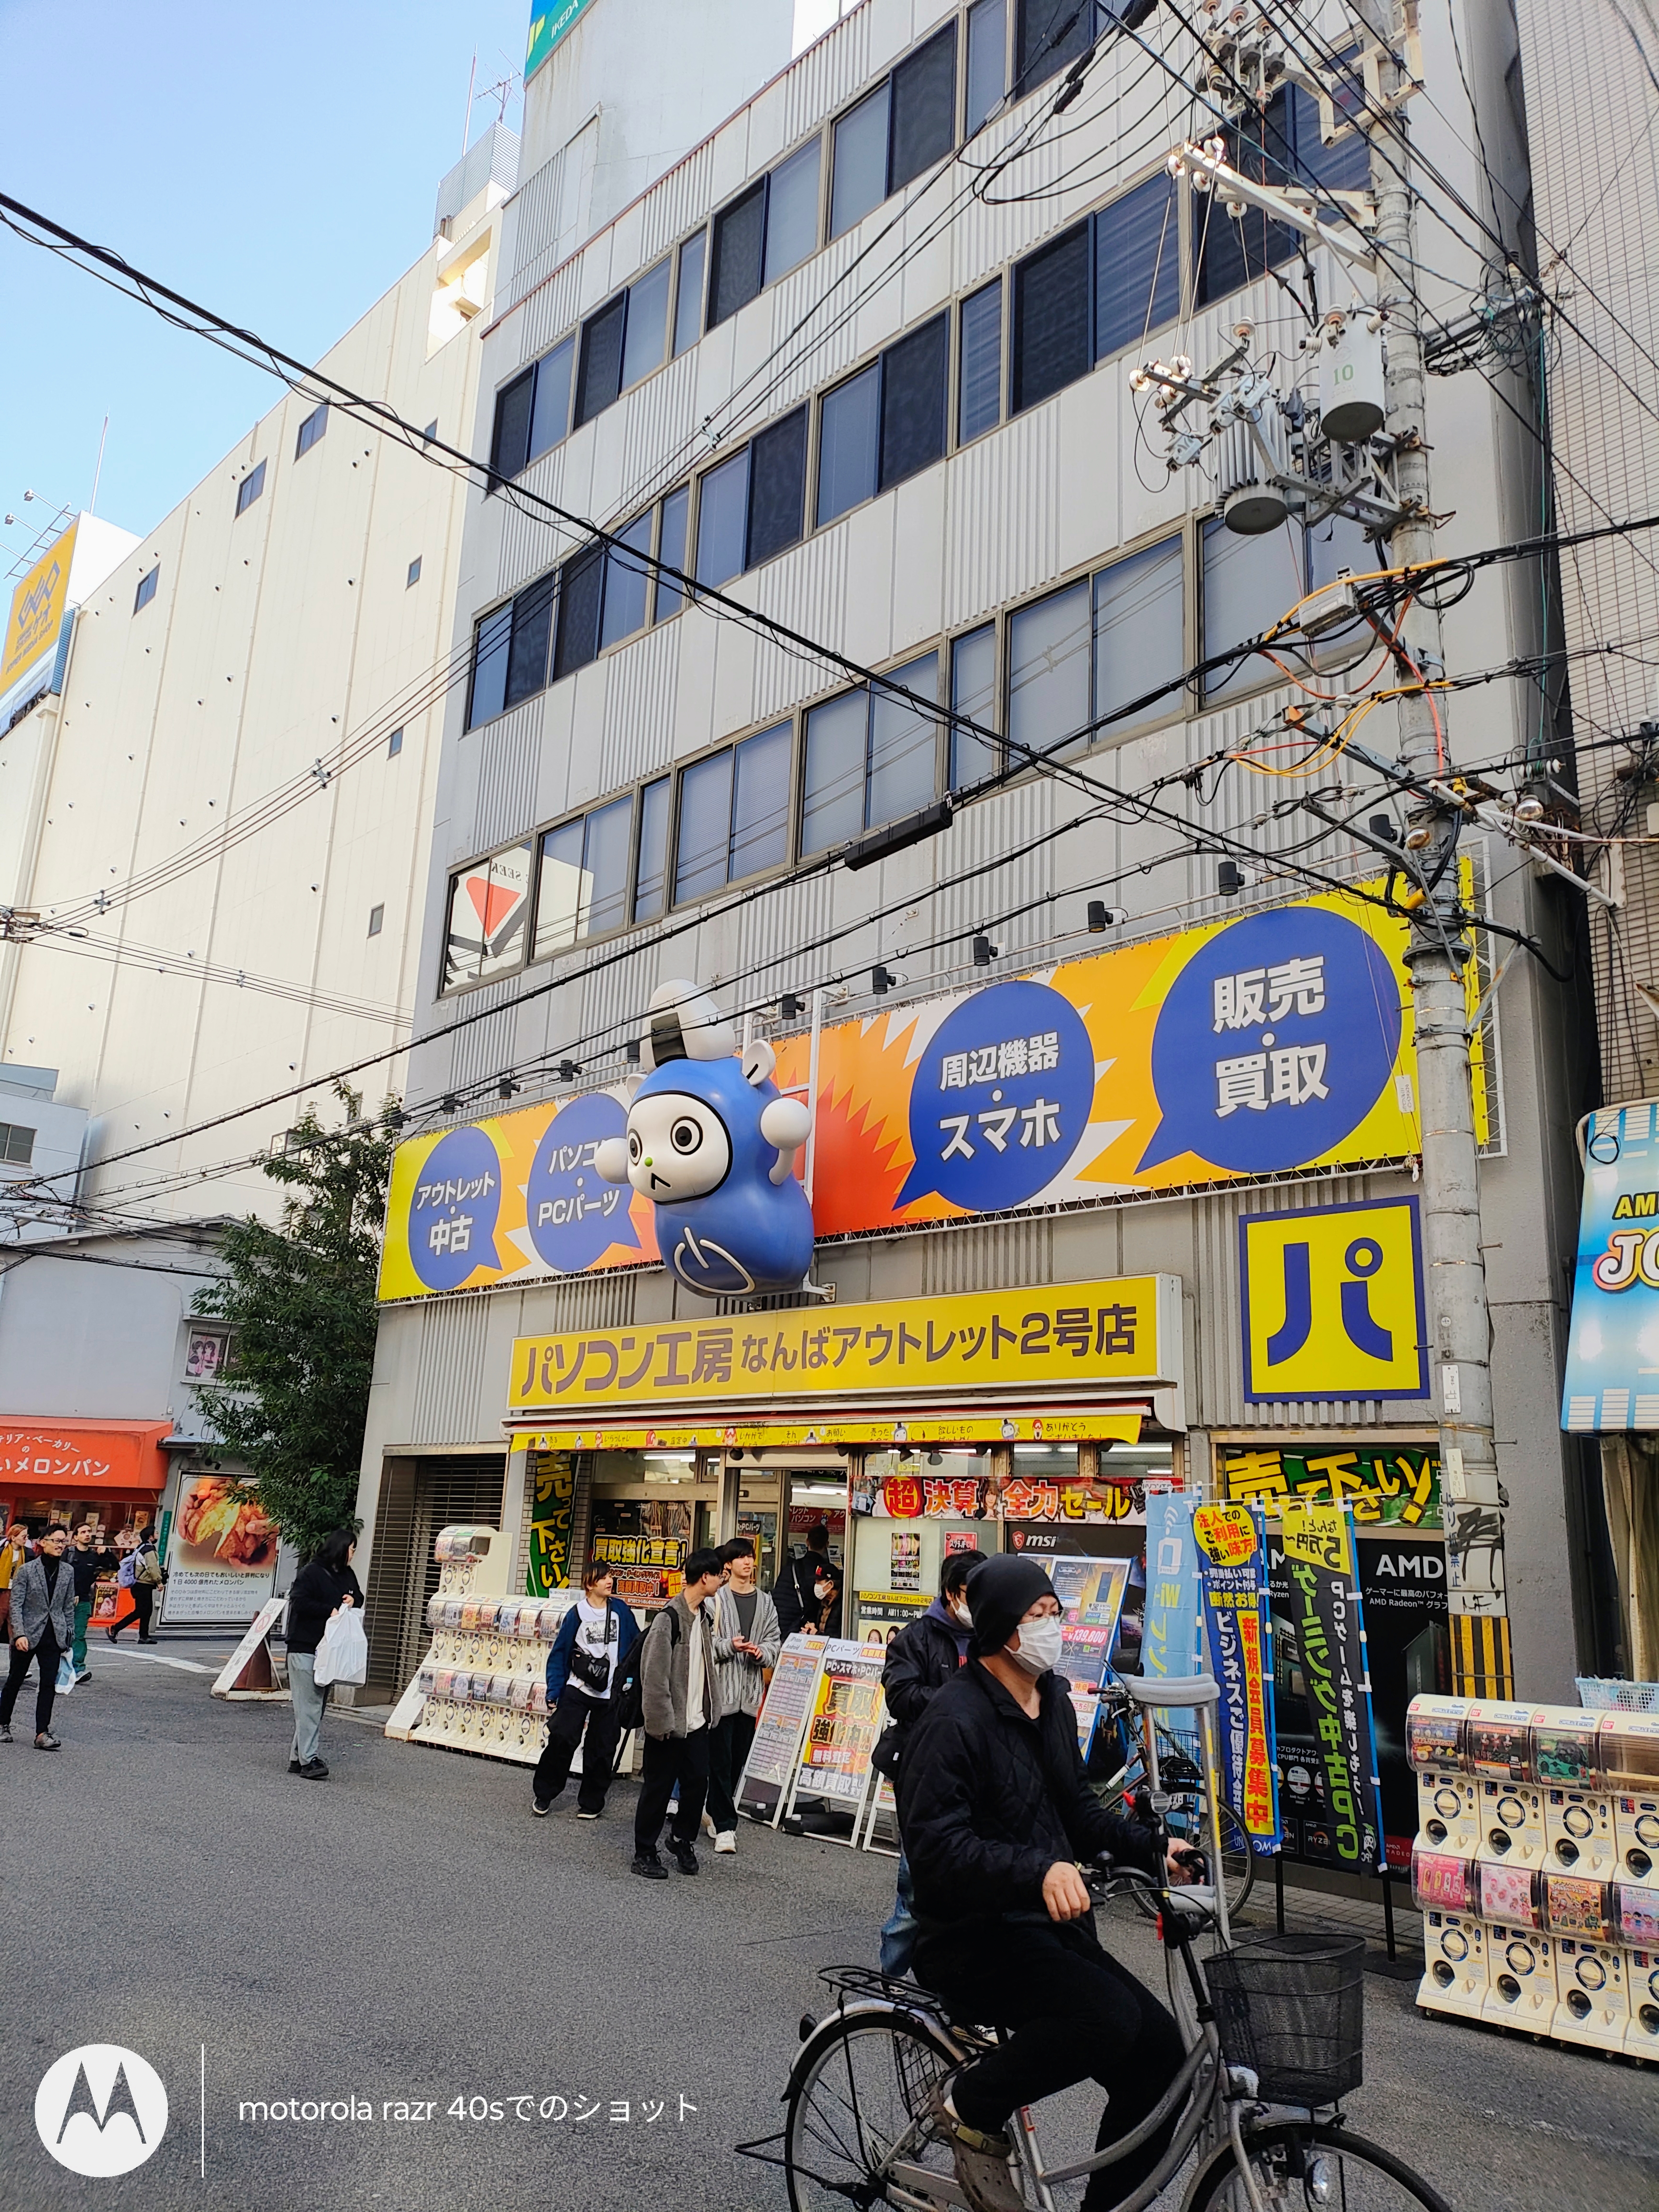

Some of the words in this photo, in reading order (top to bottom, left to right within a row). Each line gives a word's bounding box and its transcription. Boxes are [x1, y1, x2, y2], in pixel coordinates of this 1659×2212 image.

[551, 0, 578, 39] IKEDA
[1333, 364, 1354, 385] 10
[1212, 955, 1326, 1032] 販売
[939, 1031, 1060, 1092] 周辺機器
[1215, 1043, 1330, 1118] 買取
[939, 1098, 1061, 1161] スマホ
[549, 1140, 608, 1175] パソコ
[416, 1171, 496, 1210] アウトレット
[538, 1189, 620, 1228] PCパーツ
[1614, 1194, 1659, 1219] AM
[429, 1214, 474, 1257] 中古
[1267, 1237, 1394, 1367] パ
[521, 1327, 734, 1397] パソコン工房
[741, 1303, 1138, 1371] なんばアウトレット2号店
[1046, 1422, 1086, 1432] ありがとう
[0, 1433, 81, 1453] リア・ベーカリー
[22, 1445, 30, 1453] の
[888, 1479, 915, 1512] 超
[924, 1479, 979, 1516] 決算
[1005, 1479, 1059, 1520] 全力
[1061, 1486, 1130, 1519] セール
[791, 1514, 816, 1523] パソコン
[1196, 1510, 1240, 1528] 法人での
[1026, 1534, 1057, 1548] msi
[1204, 1523, 1250, 1544] ご利用に
[595, 1537, 686, 1566] 買取強化宣言!
[1208, 1535, 1256, 1562] 強い味方!
[1375, 1554, 1444, 1579] AMD
[618, 1579, 660, 1596] 高額買取中!
[1269, 1591, 1289, 1599] Ryzen
[861, 1605, 883, 1616] 営業時間
[1208, 1591, 1260, 1608] 断然お得!
[1068, 1628, 1106, 1643] ¥139,800
[826, 1644, 860, 1656] PCパーツ
[825, 1660, 885, 1677] PC・スマホ・PCパー
[827, 1681, 876, 1719] 買取
[1242, 1616, 1268, 1828] 新規会員募集中
[813, 1750, 852, 1764] 無料査定
[1276, 1746, 1318, 1757] mプロダクトアワ
[798, 1768, 852, 1794] 高額買取
[1307, 1836, 1330, 1845] RYZE
[1386, 1849, 1410, 1858] RADEO
